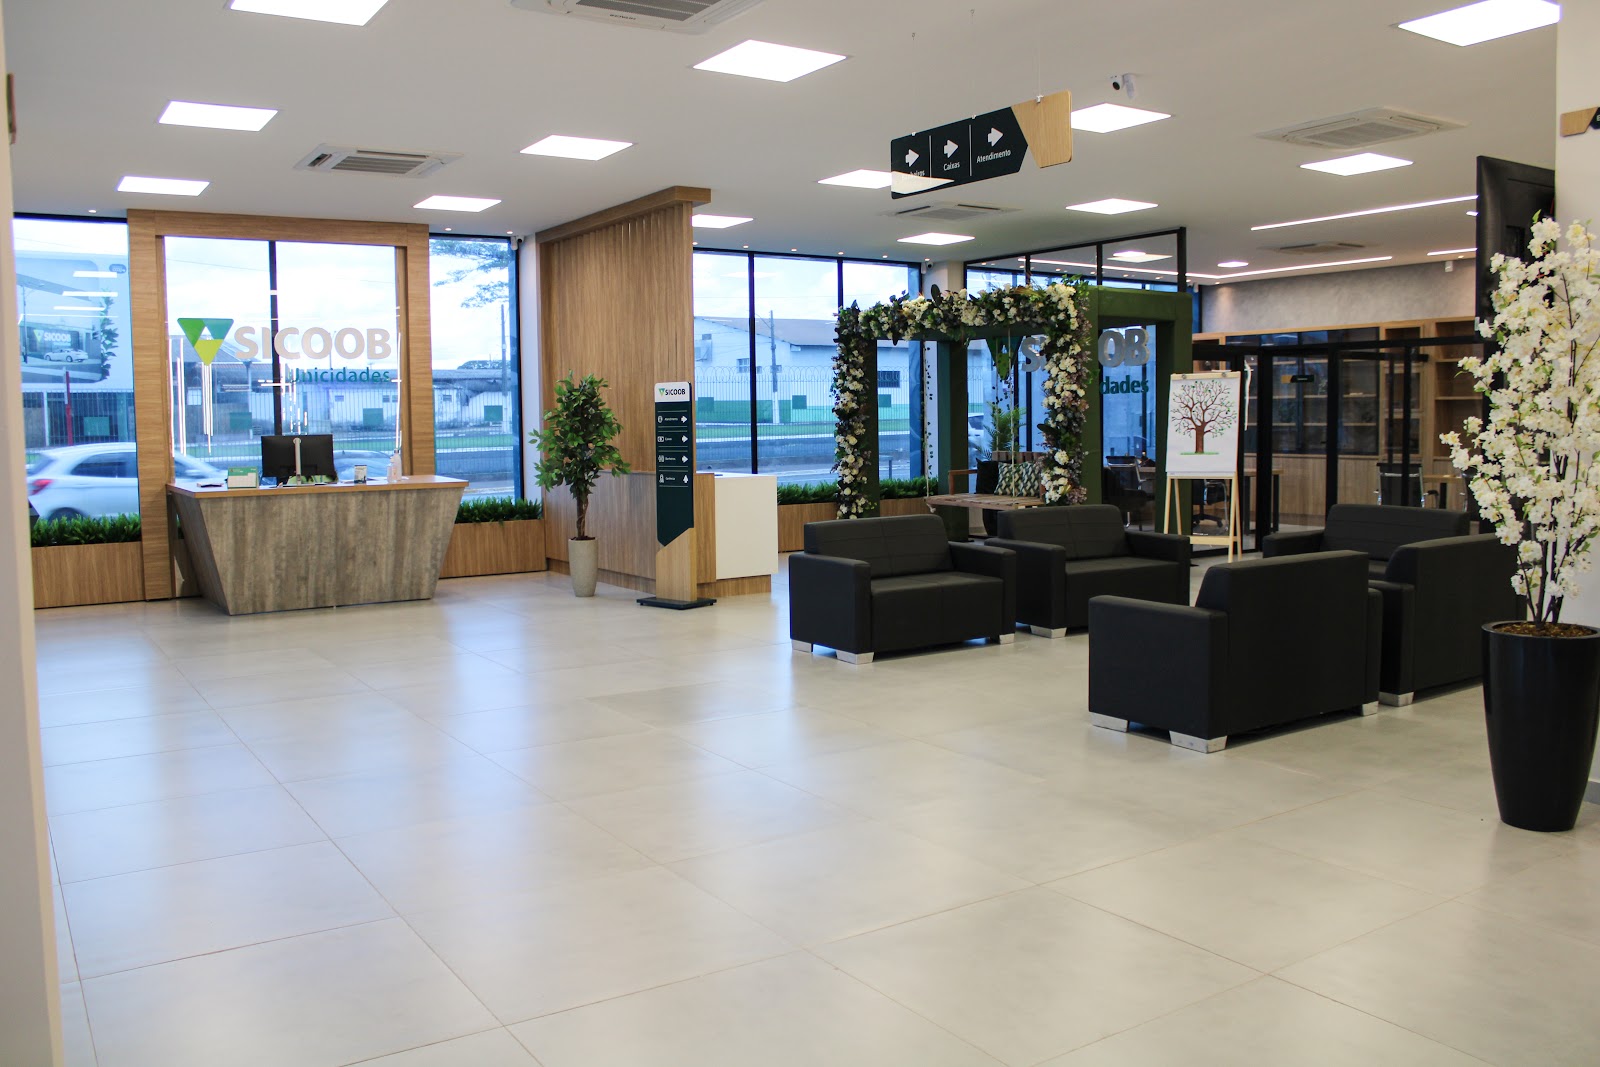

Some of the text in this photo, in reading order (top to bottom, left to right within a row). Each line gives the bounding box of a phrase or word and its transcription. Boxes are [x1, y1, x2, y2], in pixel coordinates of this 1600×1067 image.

[977, 150, 1011, 163] Atendimento
[944, 161, 960, 171] Caixas
[233, 326, 392, 360] SICOOB
[1099, 375, 1150, 395] dades
[665, 388, 686, 396] SICOOB
